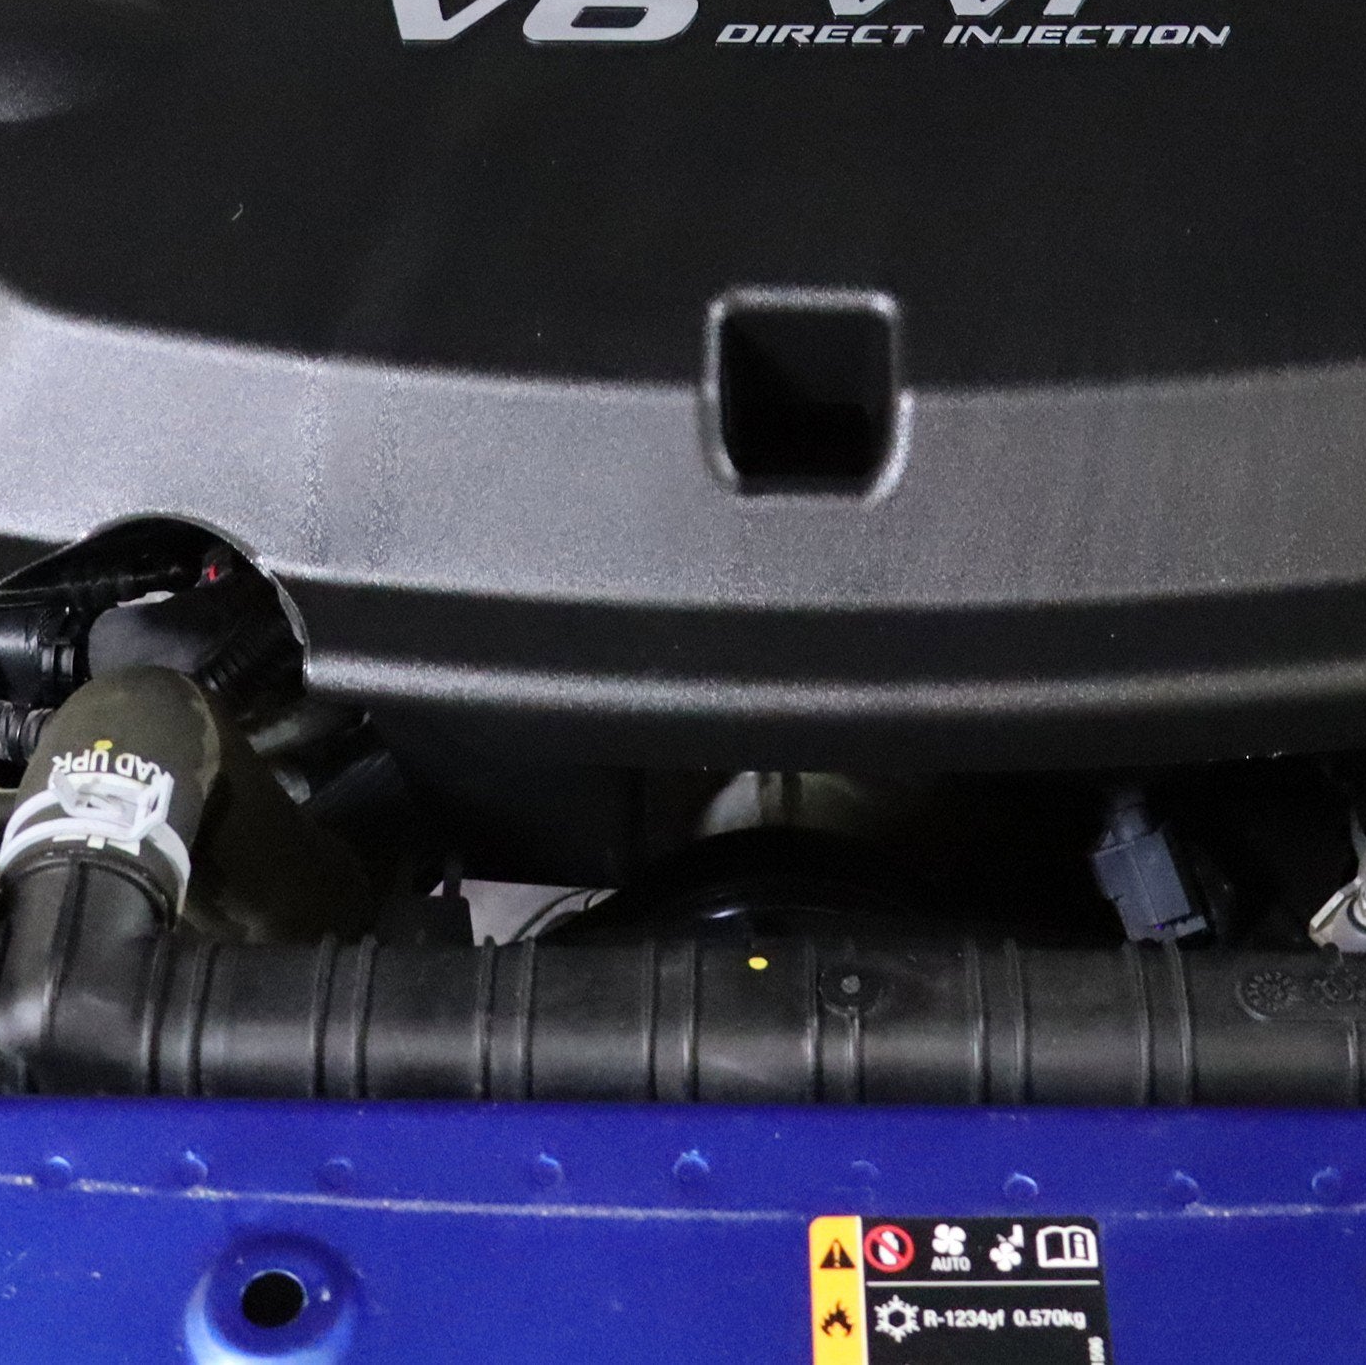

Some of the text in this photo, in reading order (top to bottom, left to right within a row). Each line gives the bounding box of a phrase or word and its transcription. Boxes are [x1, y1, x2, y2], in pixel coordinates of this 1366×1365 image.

[717, 23, 1231, 47] DIRECT INJECTION
[930, 1256, 972, 1272] AUTO
[923, 1308, 1087, 1330] R-1234yf 0.570kg
